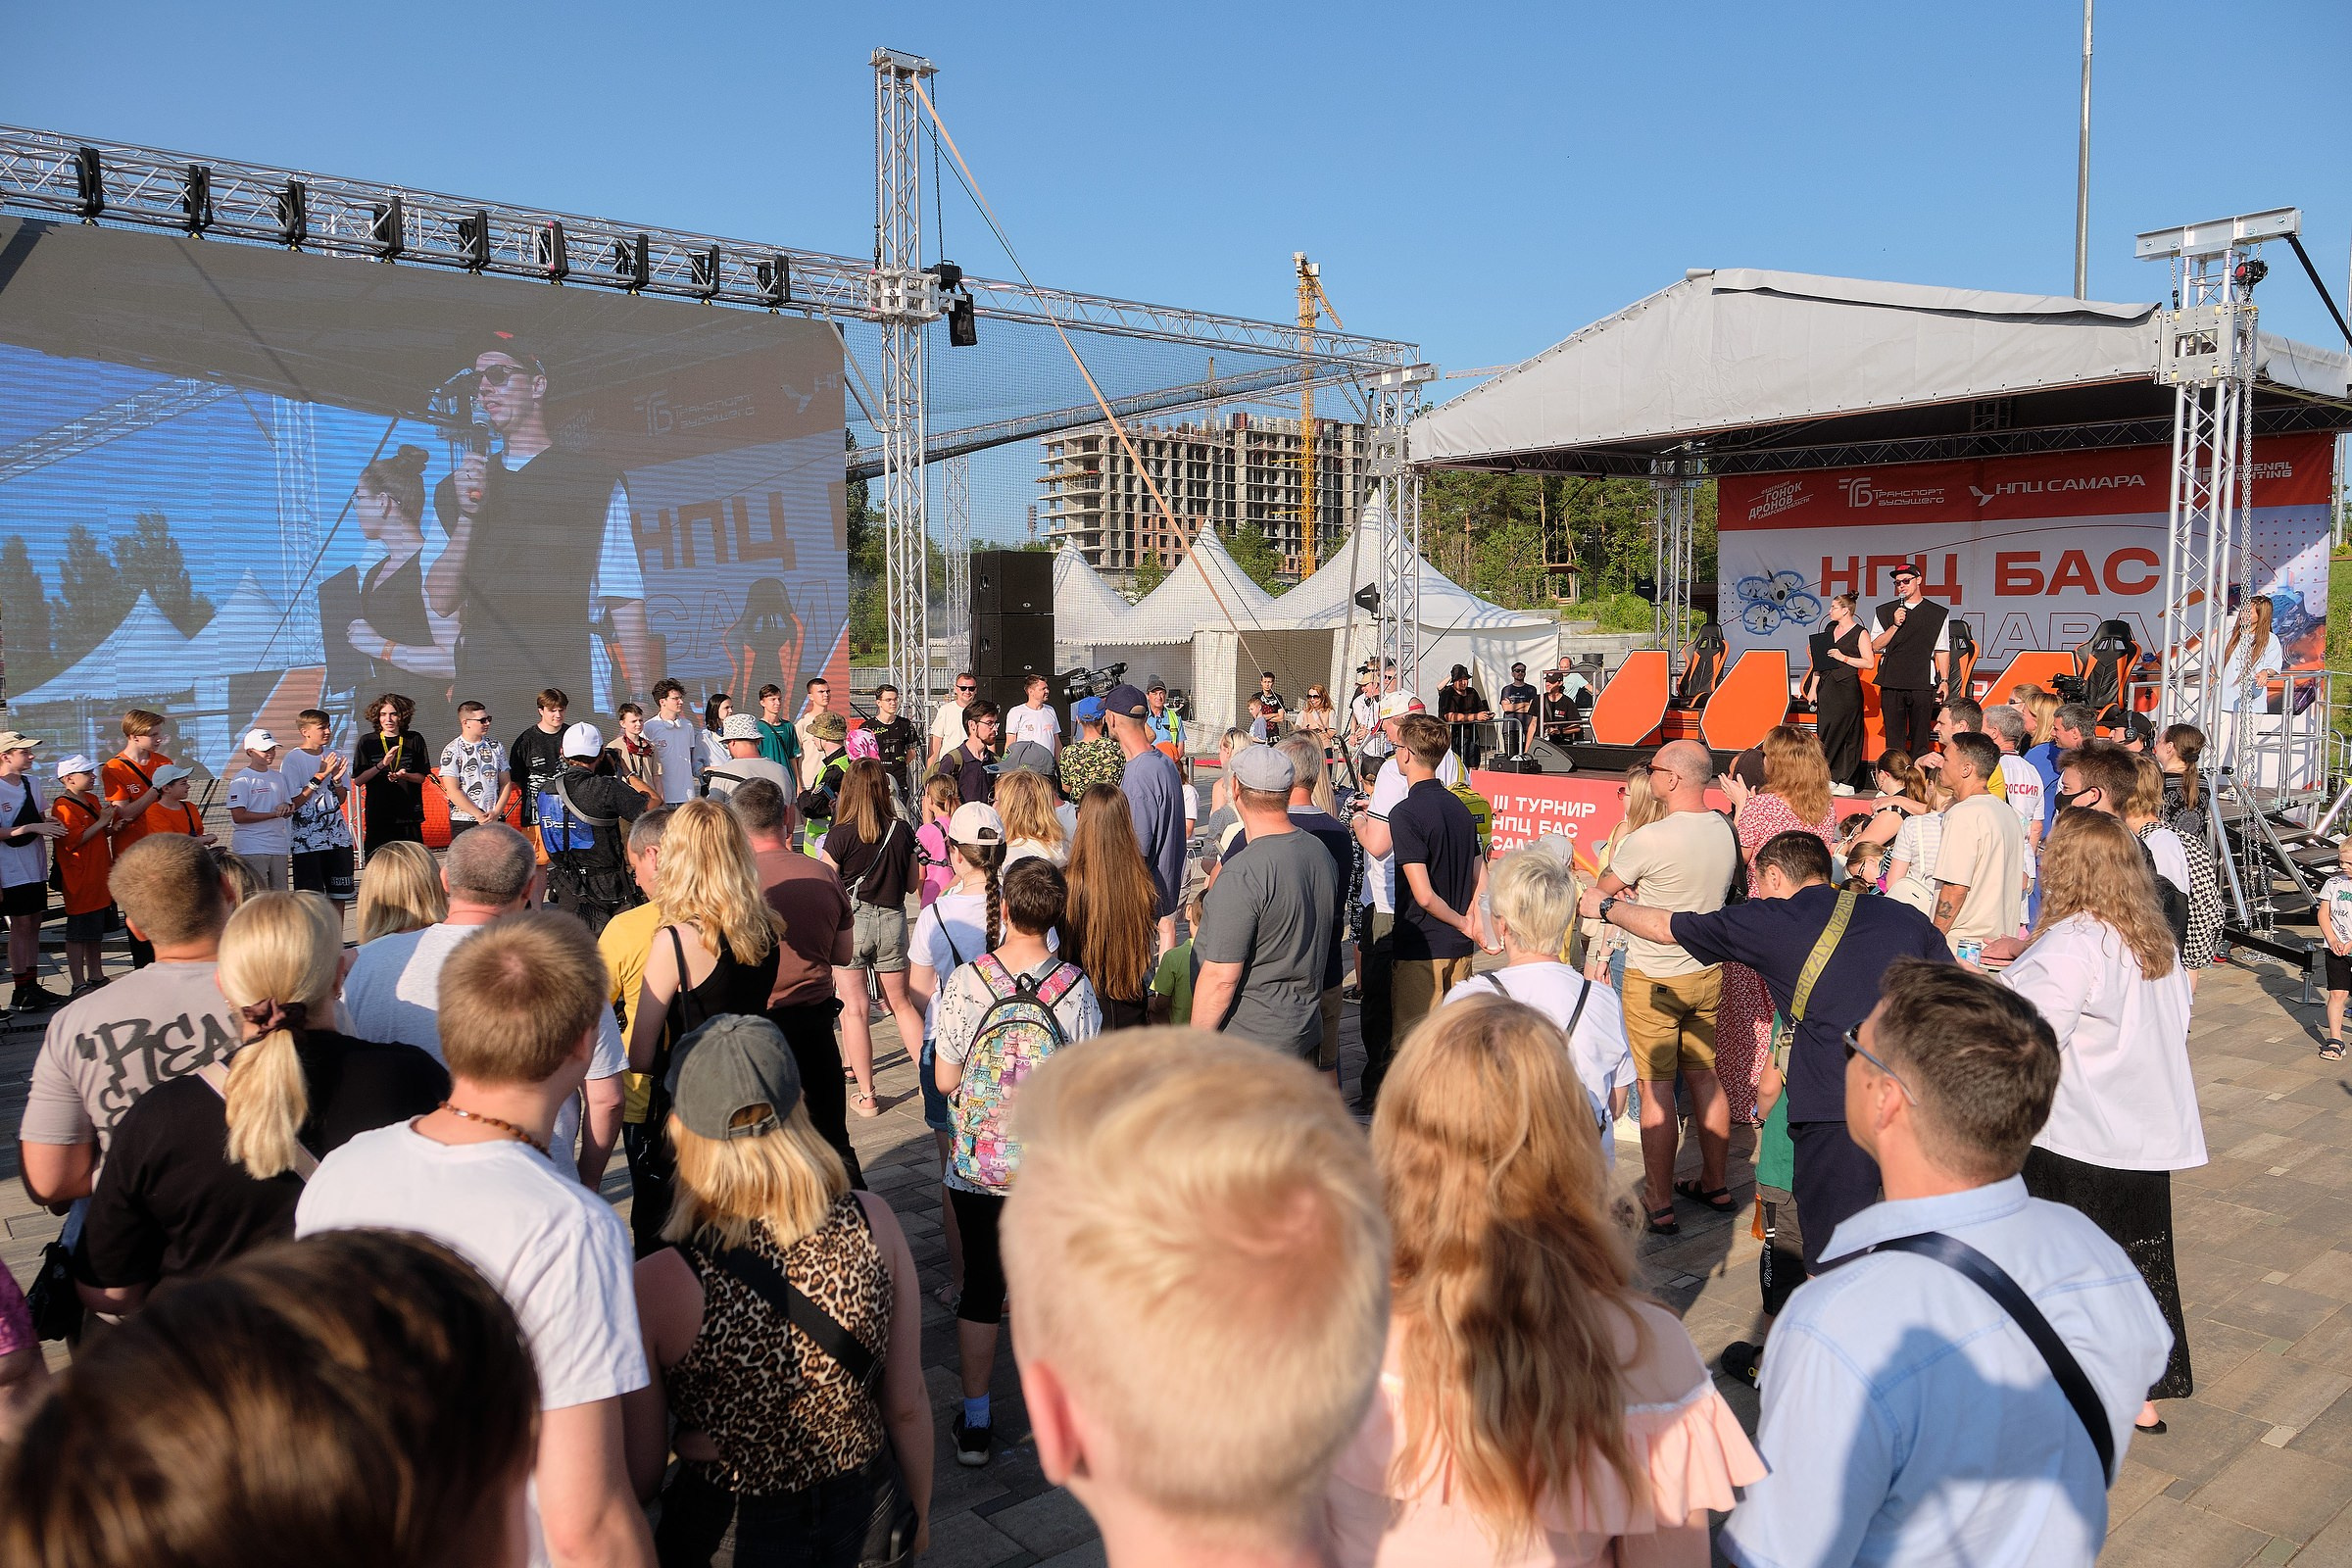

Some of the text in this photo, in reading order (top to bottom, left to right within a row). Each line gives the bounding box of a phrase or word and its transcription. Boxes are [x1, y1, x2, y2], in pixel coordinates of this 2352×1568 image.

[1765, 481, 1803, 503] ГОНОК
[2046, 474, 2146, 492] САМАРА
[1748, 495, 1793, 520] ДРОНОВ
[632, 491, 797, 572] НПЦ
[1994, 547, 2161, 597] БАС
[1515, 796, 1596, 818] ТУРНИР
[1492, 815, 1579, 839] НПЦ БАС
[1491, 835, 1535, 853] САМ
[1830, 891, 1855, 939] GRIZZLY
[1793, 939, 1833, 1009] GRIZZLY
